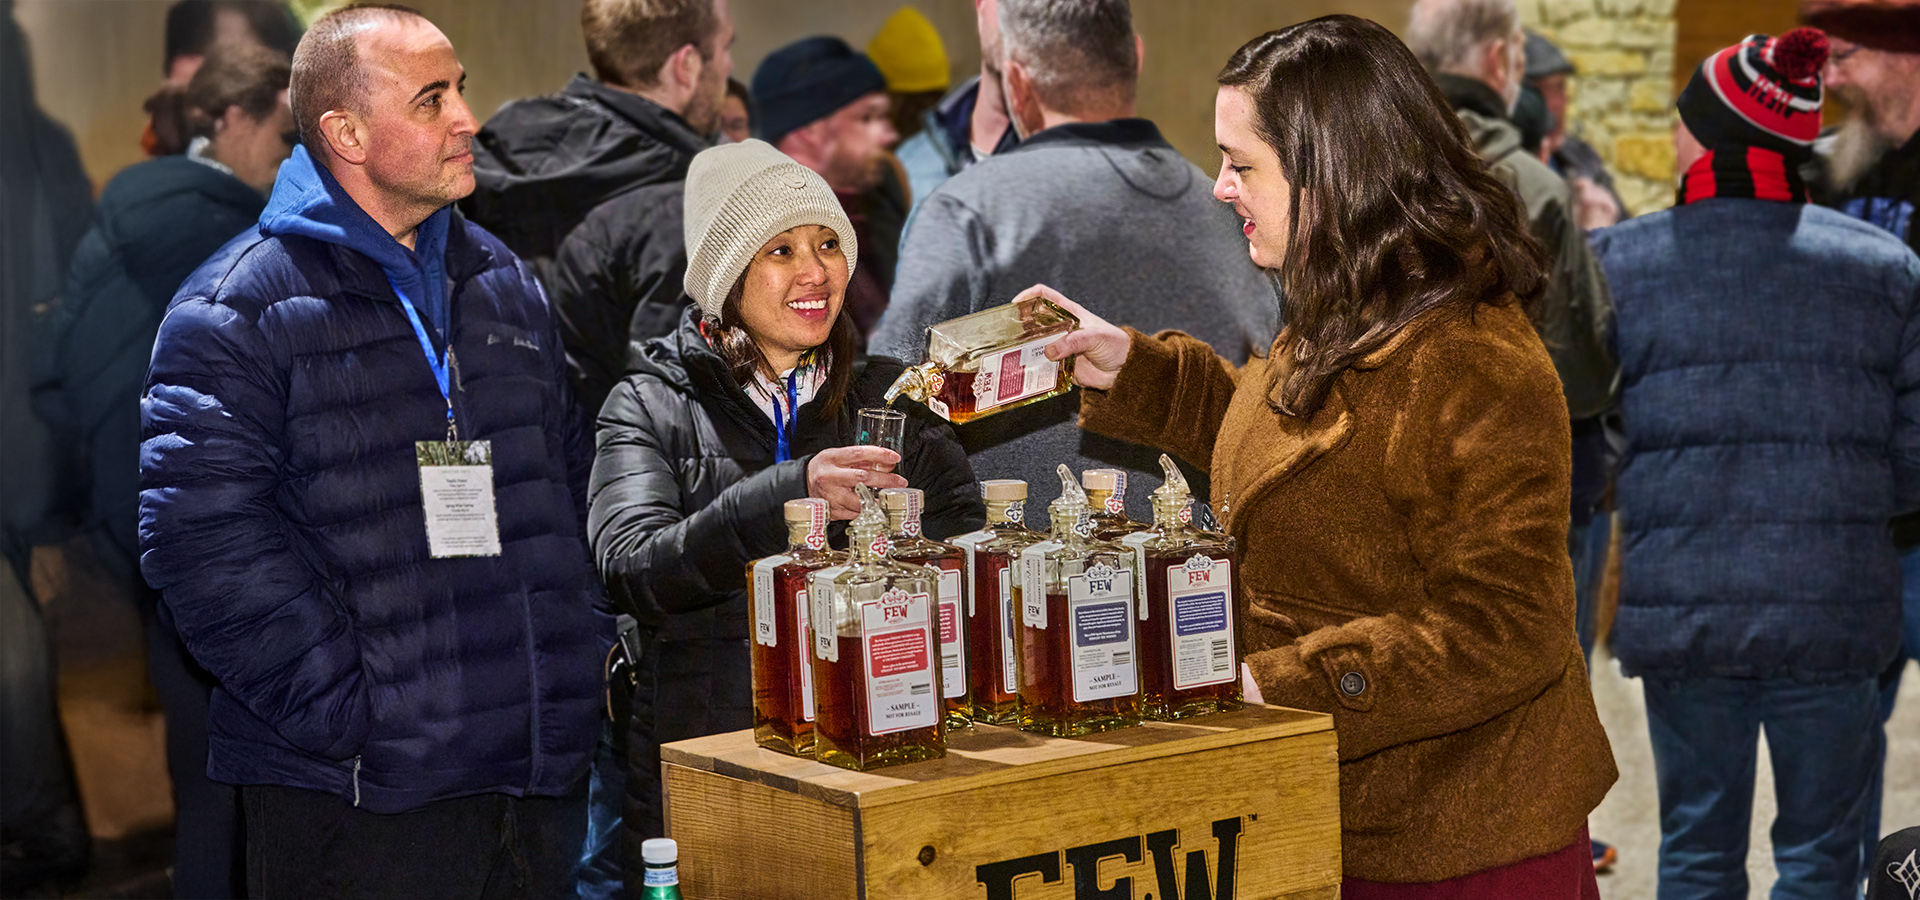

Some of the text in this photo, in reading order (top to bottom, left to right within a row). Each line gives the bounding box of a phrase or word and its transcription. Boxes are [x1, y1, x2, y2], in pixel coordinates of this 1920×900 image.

[983, 372, 993, 393] FEW
[932, 401, 945, 414] FEW
[1188, 570, 1210, 585] FEW
[1090, 579, 1112, 594] FEW
[884, 604, 908, 622] FEW
[1028, 605, 1040, 615] FEW
[760, 622, 770, 632] FEW
[820, 636, 831, 648] FEW
[1094, 674, 1116, 683] SAMPLE
[890, 702, 916, 711] SAMPLE
